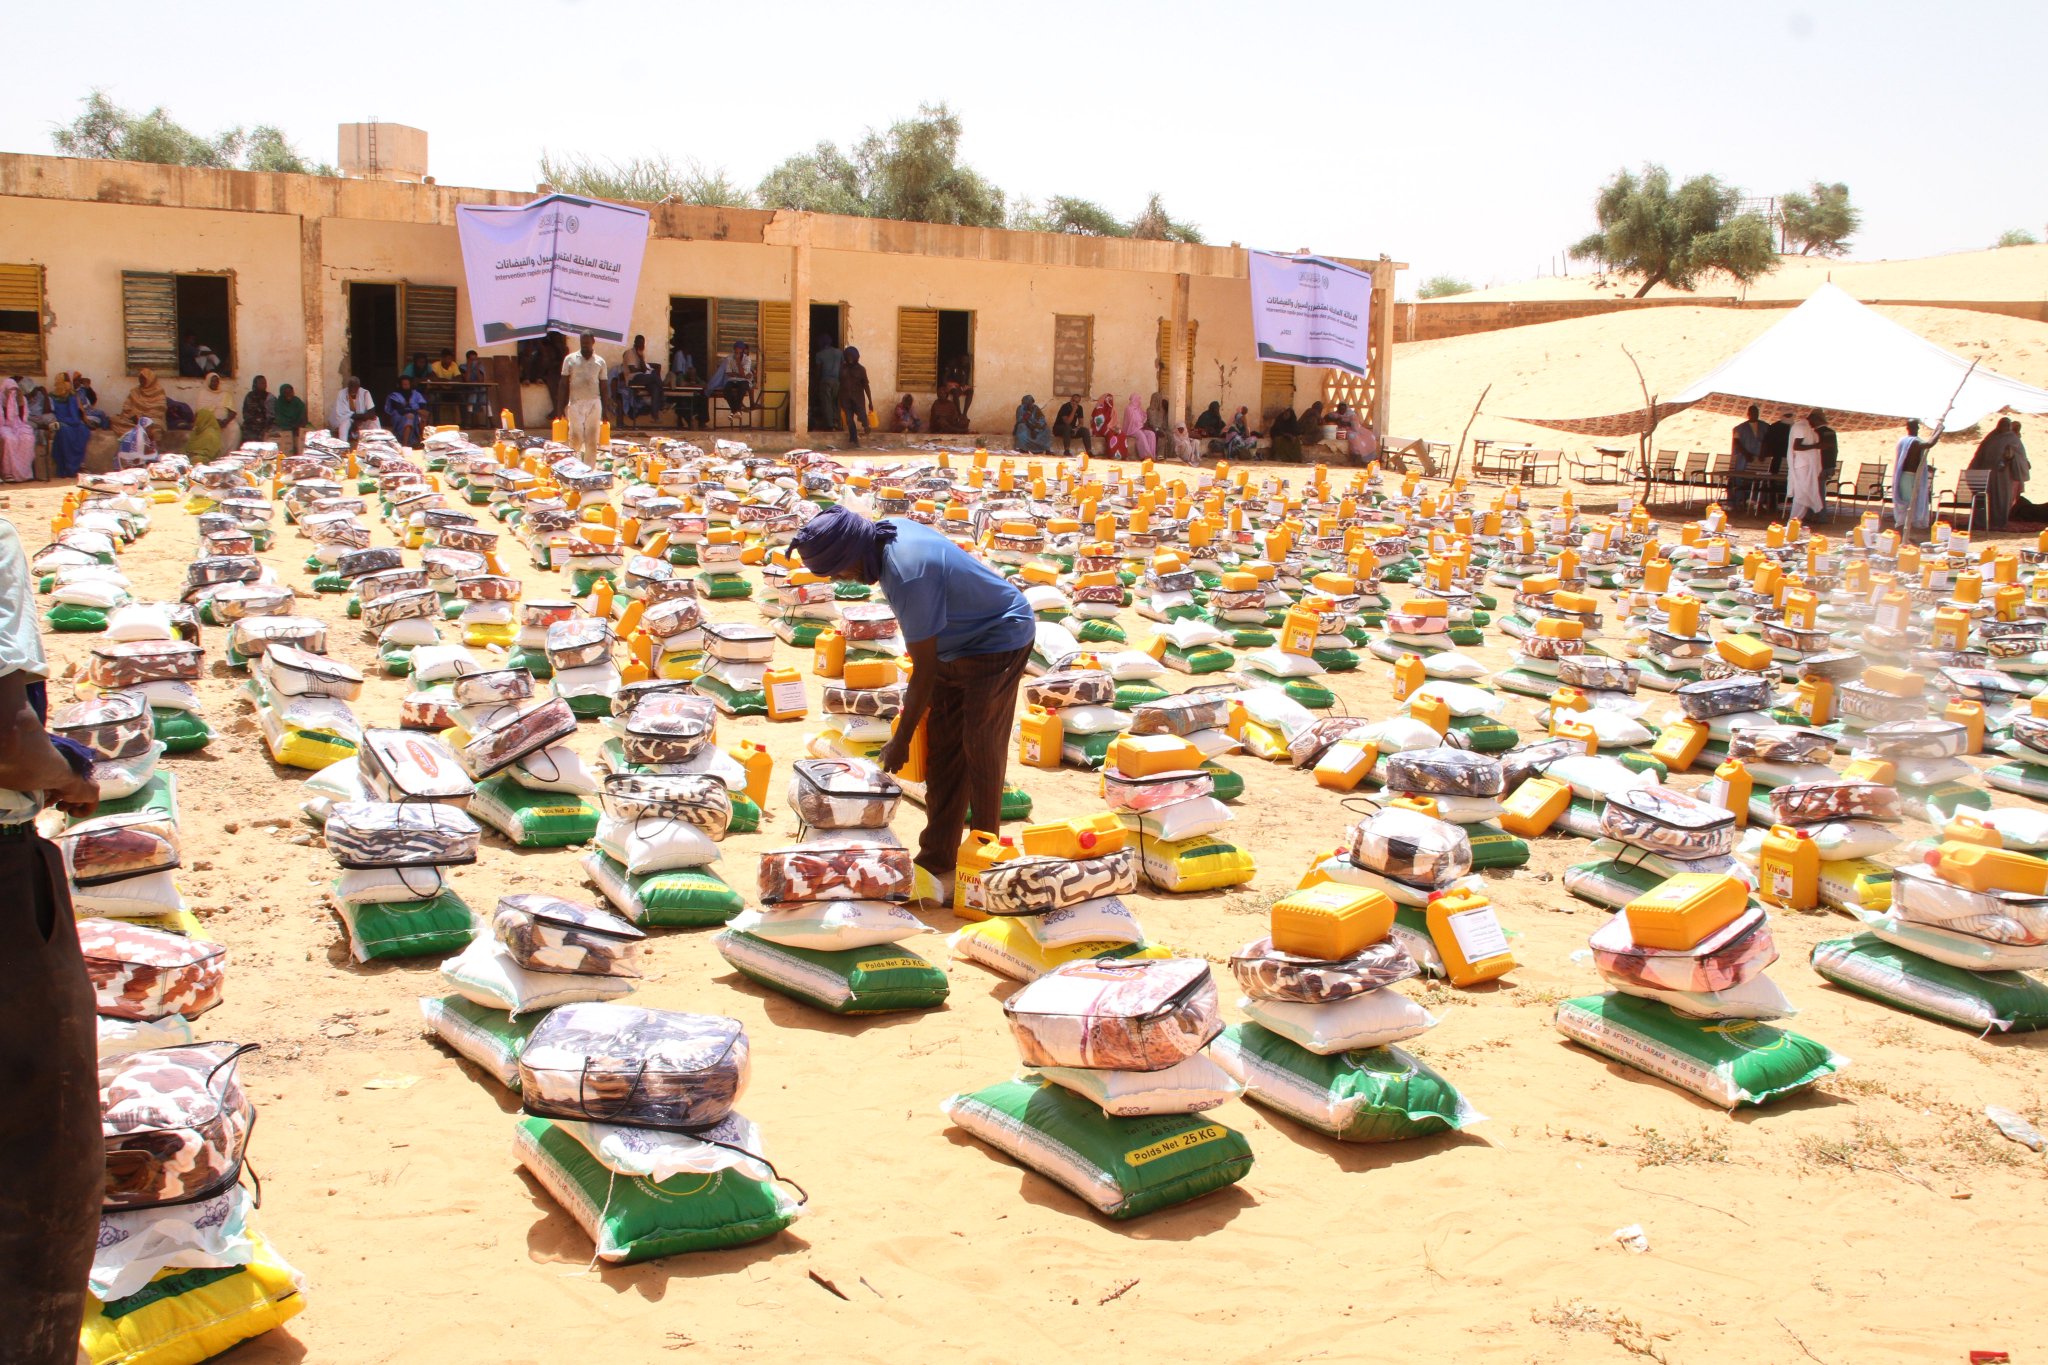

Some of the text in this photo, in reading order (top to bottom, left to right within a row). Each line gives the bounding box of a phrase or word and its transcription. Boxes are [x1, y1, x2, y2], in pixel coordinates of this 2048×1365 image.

[573, 254, 597, 268] العاجلة
[599, 262, 621, 275] الإغاثة
[494, 271, 526, 281] Intervention
[590, 271, 620, 283] inondations
[1766, 863, 1791, 877] VIKING
[958, 871, 982, 886] VIKIN
[900, 959, 911, 967] 25
[912, 959, 925, 967] KG
[1612, 1032, 1634, 1045] AFTOUT
[1635, 1042, 1642, 1050] AL
[1642, 1045, 1667, 1061] BARAKA
[1162, 1140, 1180, 1151] Net
[1182, 1133, 1198, 1146] 25
[1199, 1128, 1217, 1140] KG
